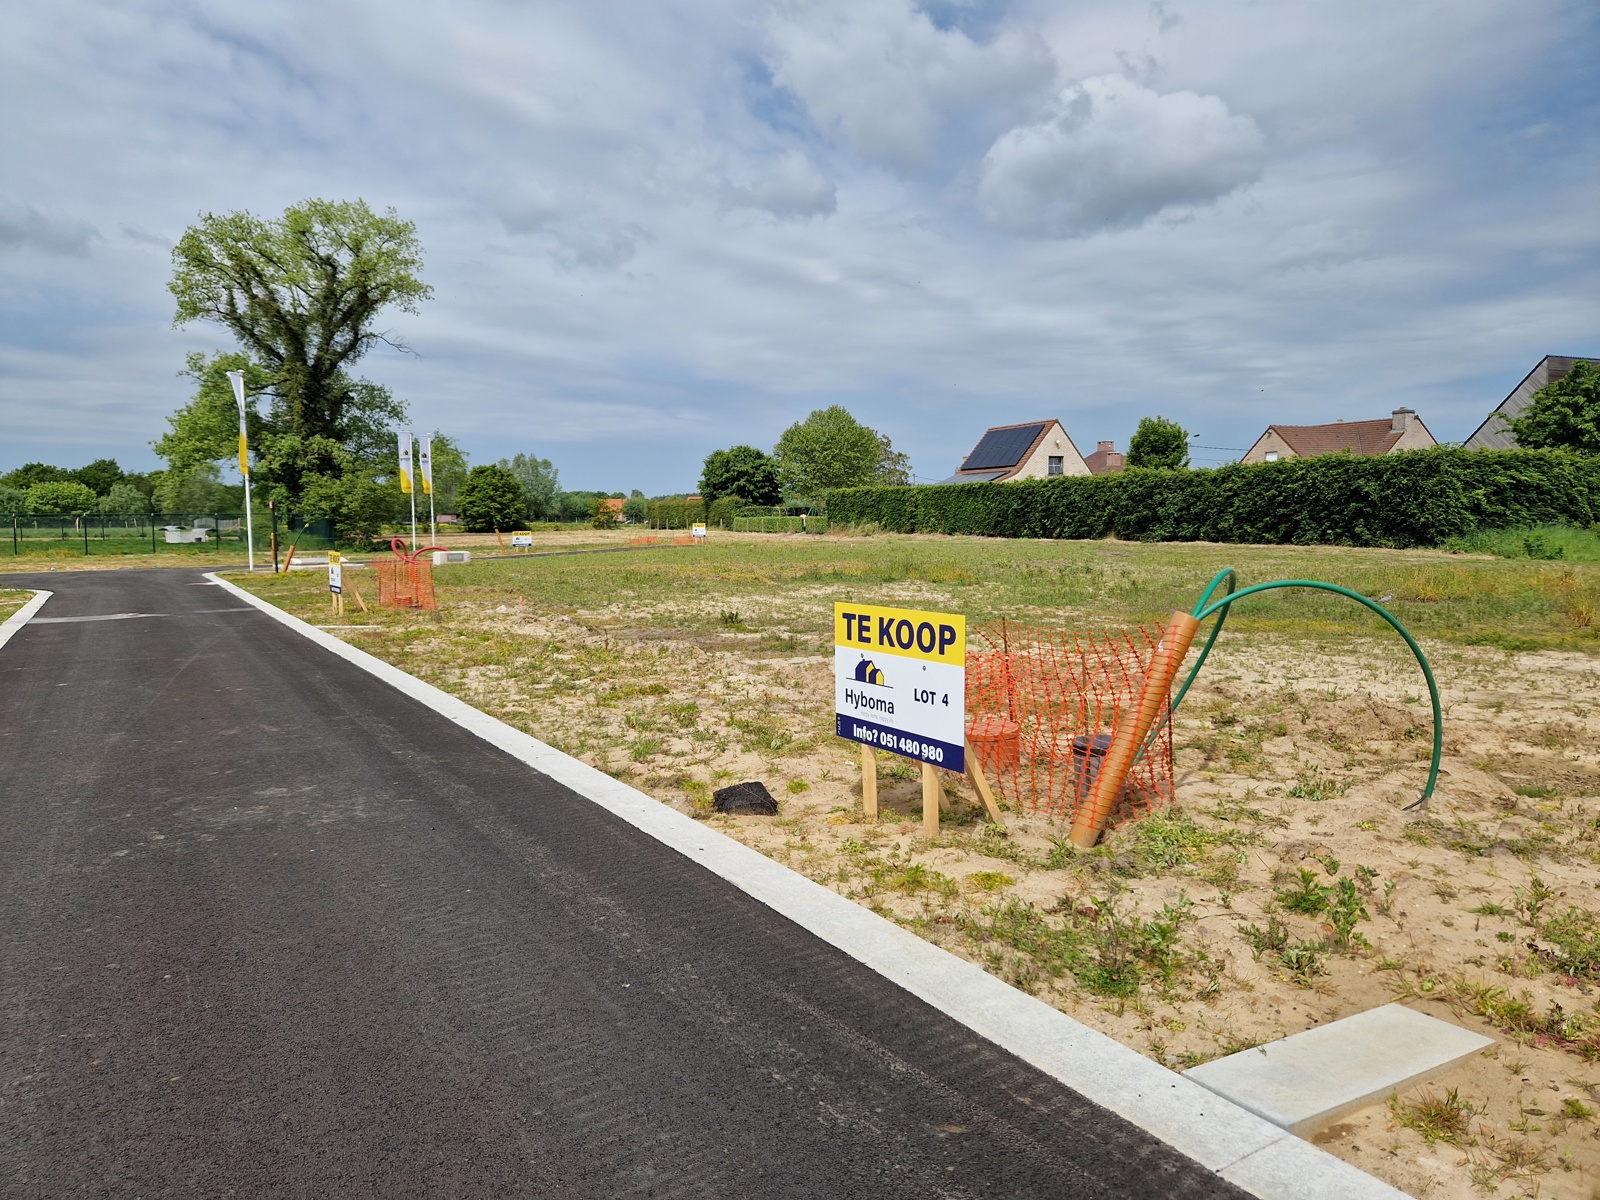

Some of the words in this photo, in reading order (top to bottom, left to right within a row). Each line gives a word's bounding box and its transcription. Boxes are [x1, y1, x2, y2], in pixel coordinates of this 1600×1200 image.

[842, 612, 871, 644] TE
[878, 616, 957, 656] KOOP
[845, 687, 895, 715] Hyboma
[914, 688, 936, 705] LOT
[942, 693, 949, 707] 4
[853, 723, 878, 743] Info?
[880, 731, 897, 749] 051
[899, 737, 920, 756] 480
[921, 743, 944, 762] 980
